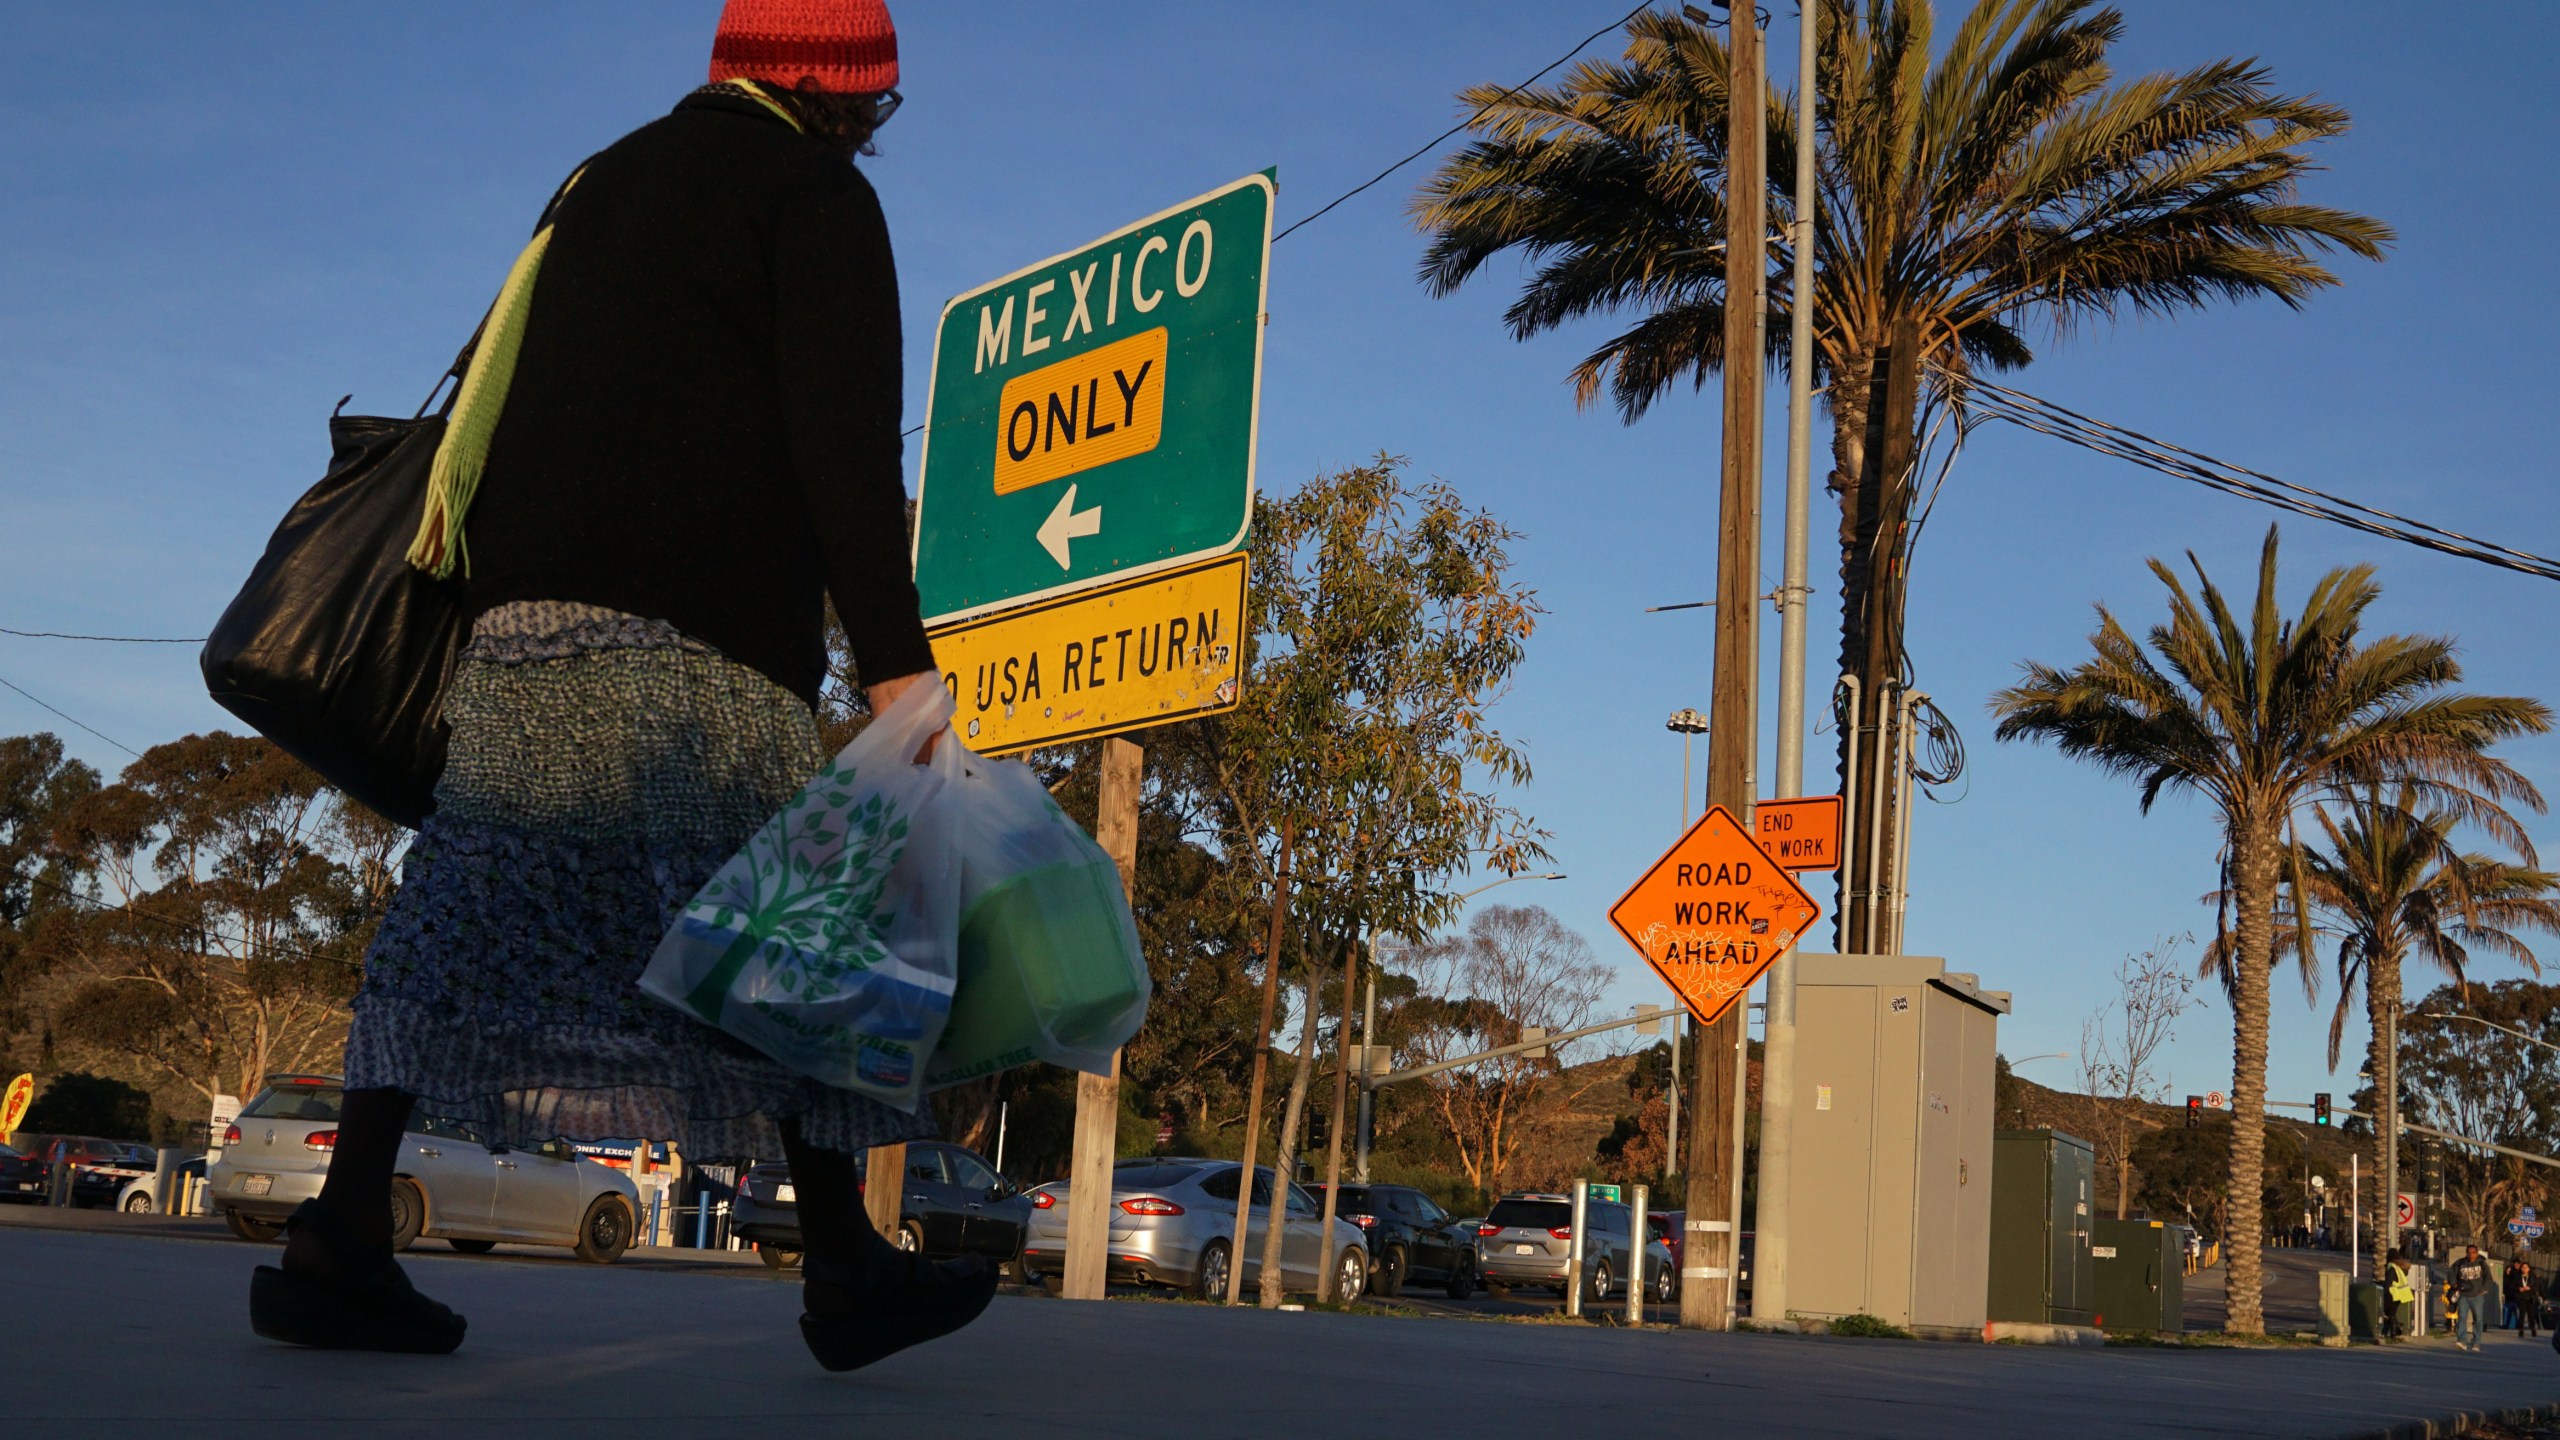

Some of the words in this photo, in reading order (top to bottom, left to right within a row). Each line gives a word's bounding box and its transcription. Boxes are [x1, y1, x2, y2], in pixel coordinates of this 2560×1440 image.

[974, 219, 1213, 375] MEXICO
[1007, 359, 1154, 463] ONLY
[977, 651, 1041, 712] USA
[1062, 608, 1219, 694] RETURN
[1763, 813, 1793, 832] END
[1780, 838, 1824, 857] WORK
[1677, 862, 1752, 887] ROAD
[1674, 901, 1752, 926] WORK
[1663, 941, 1759, 965] AHEAD
[856, 1033, 910, 1059] TREE
[997, 1046, 1035, 1068] TREE
[575, 1145, 603, 1154] ONEY
[2526, 1227, 2541, 1235] 805
